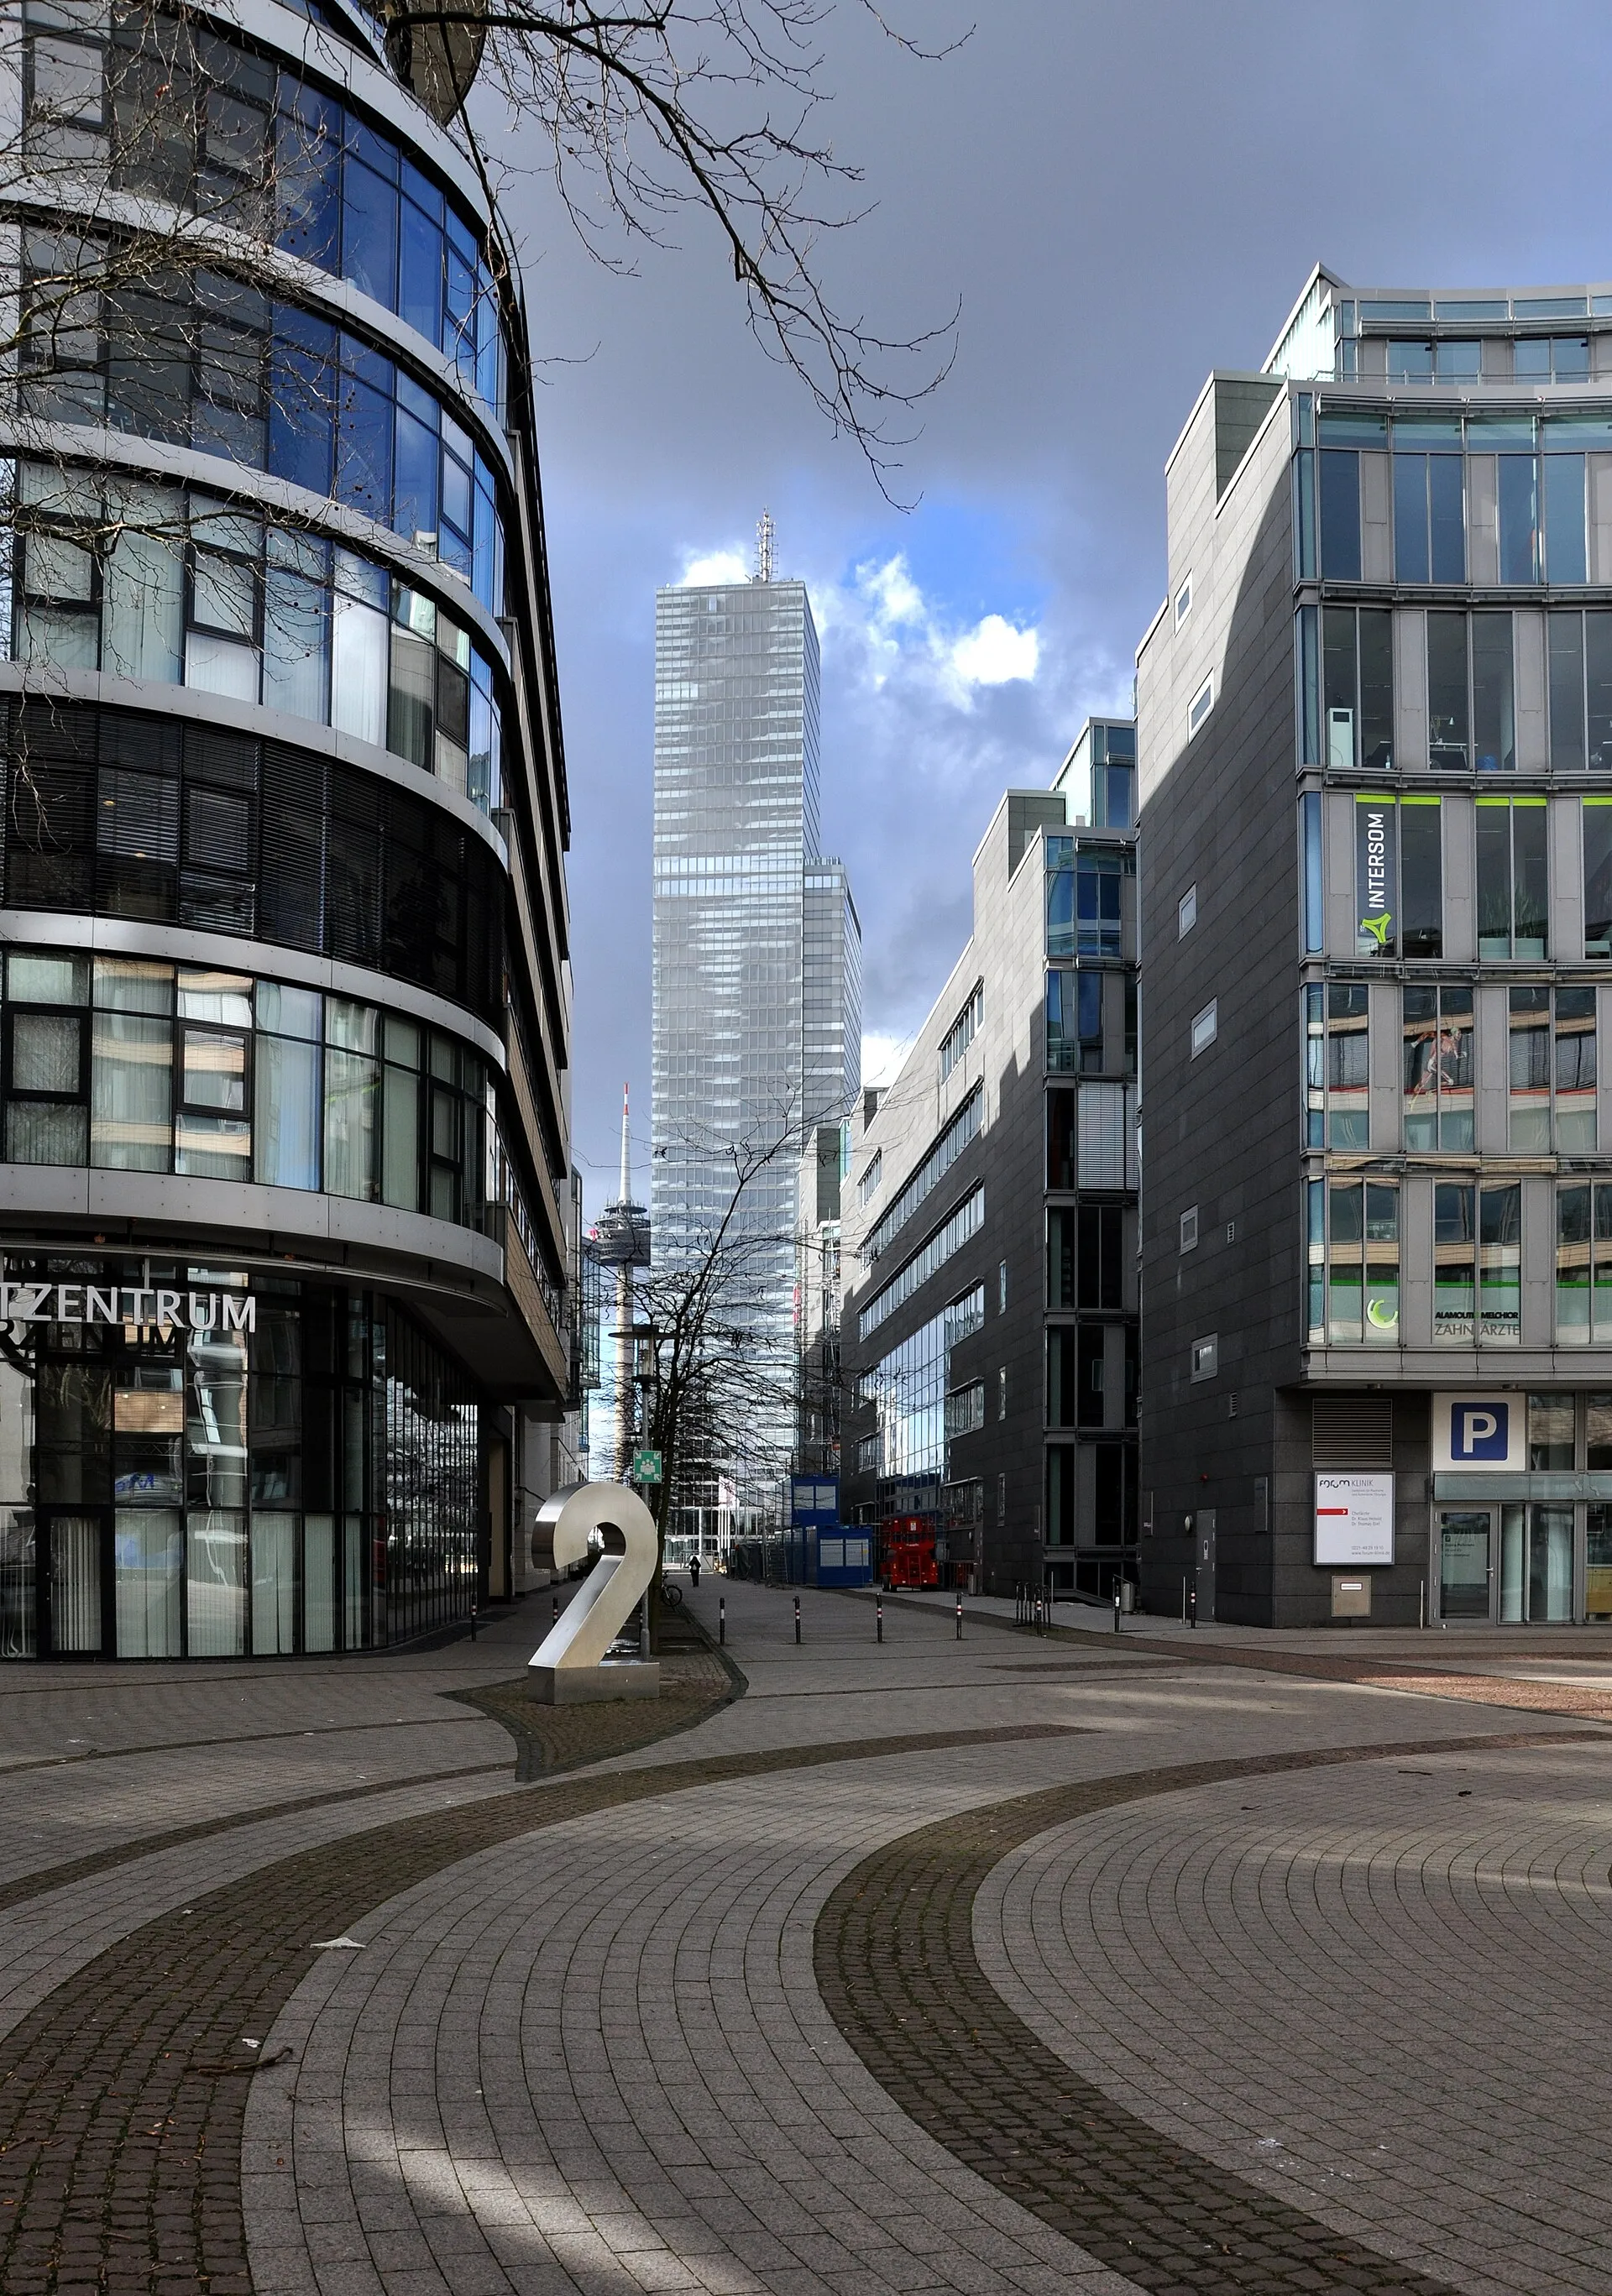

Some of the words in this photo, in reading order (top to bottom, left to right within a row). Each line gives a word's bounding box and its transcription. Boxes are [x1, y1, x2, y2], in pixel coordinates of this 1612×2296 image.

[1368, 813, 1384, 908] INTERSOM
[0, 1282, 256, 1333] TZENTRUM
[1463, 1412, 1497, 1453] P
